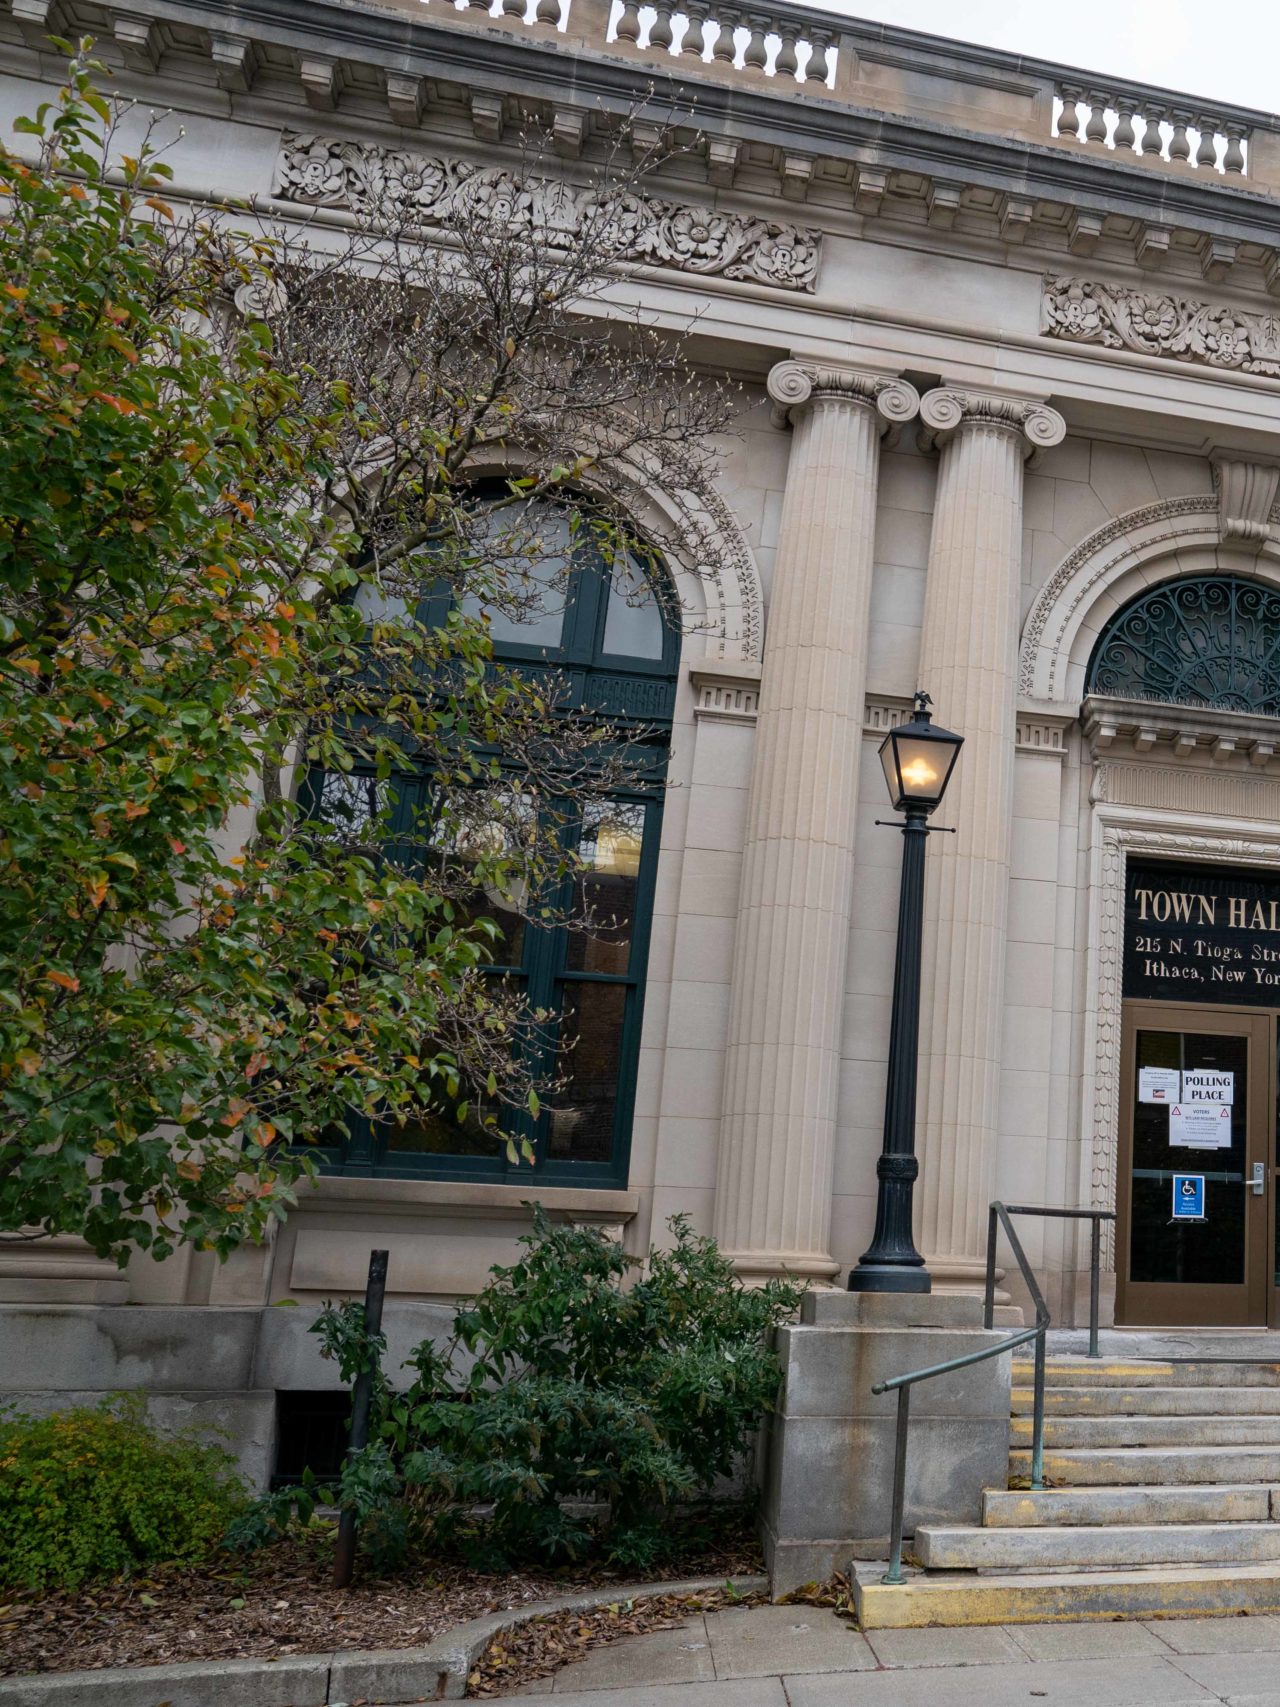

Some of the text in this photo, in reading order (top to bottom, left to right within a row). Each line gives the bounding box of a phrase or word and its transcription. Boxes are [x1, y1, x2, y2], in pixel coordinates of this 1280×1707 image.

[1134, 889, 1218, 926] TOWN
[1135, 936, 1161, 953] 215
[1168, 938, 1188, 955] N.
[1193, 940, 1243, 961] Tioga
[1144, 959, 1205, 983] Ithaca,
[1210, 965, 1247, 982] New
[1185, 1076, 1231, 1087] POLLING
[1191, 1090, 1225, 1100] PLACE
